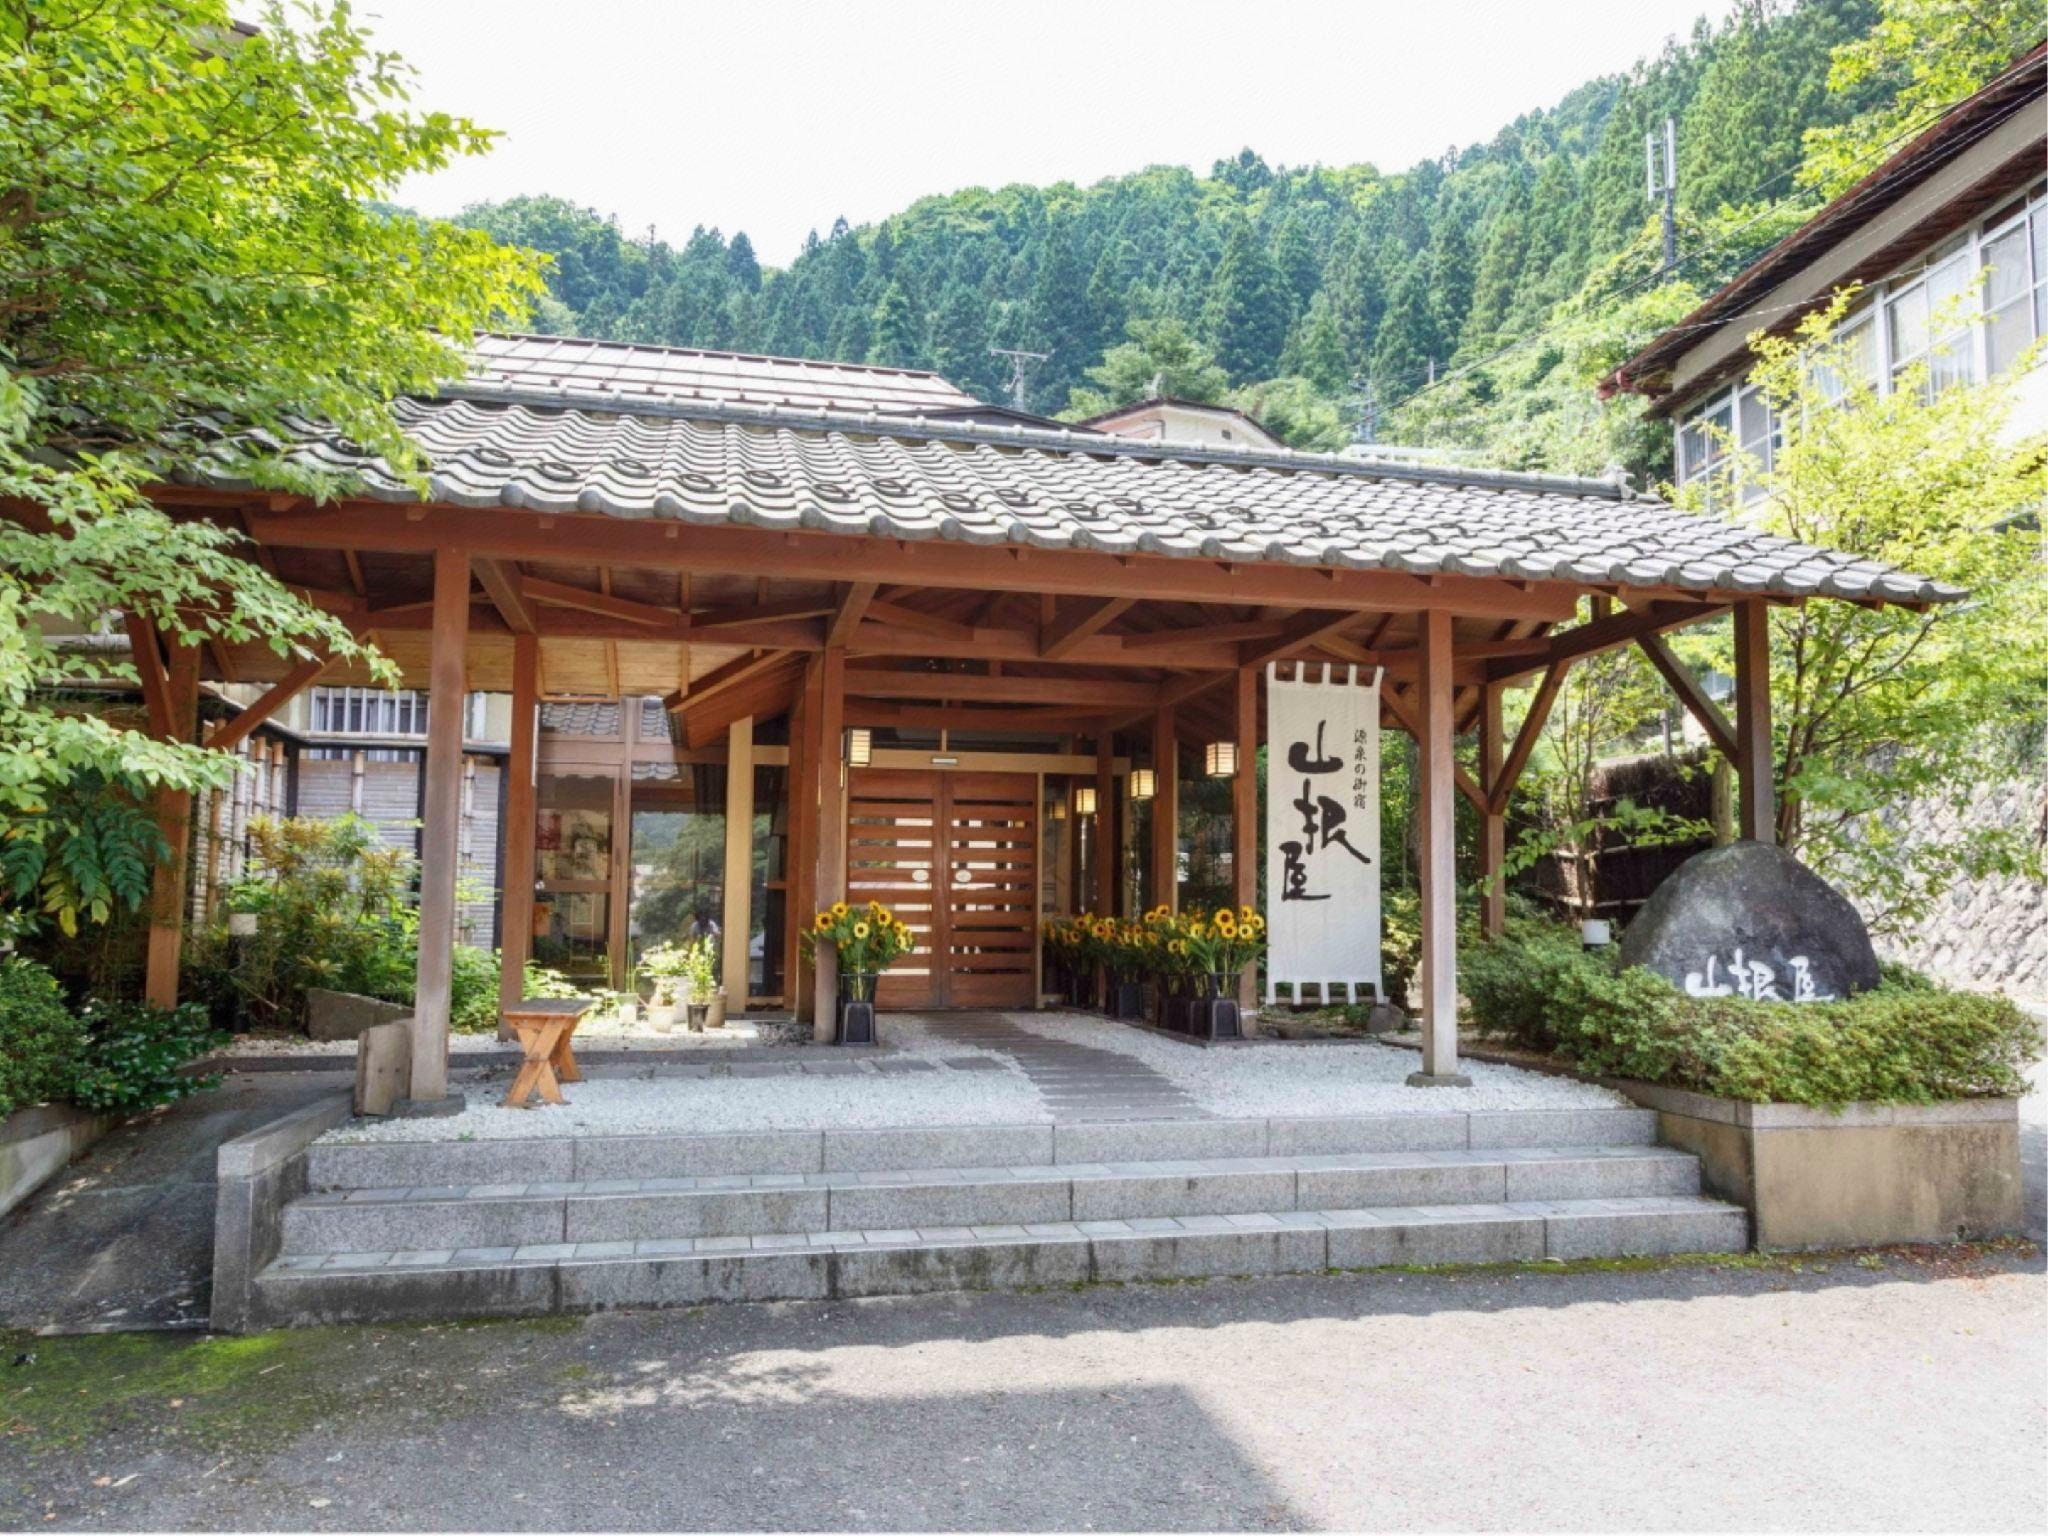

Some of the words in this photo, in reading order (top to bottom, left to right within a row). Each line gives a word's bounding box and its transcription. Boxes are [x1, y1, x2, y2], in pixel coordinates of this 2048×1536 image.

[1279, 719, 1371, 902] 山根屋
[1685, 948, 1836, 1003] 山根屋
